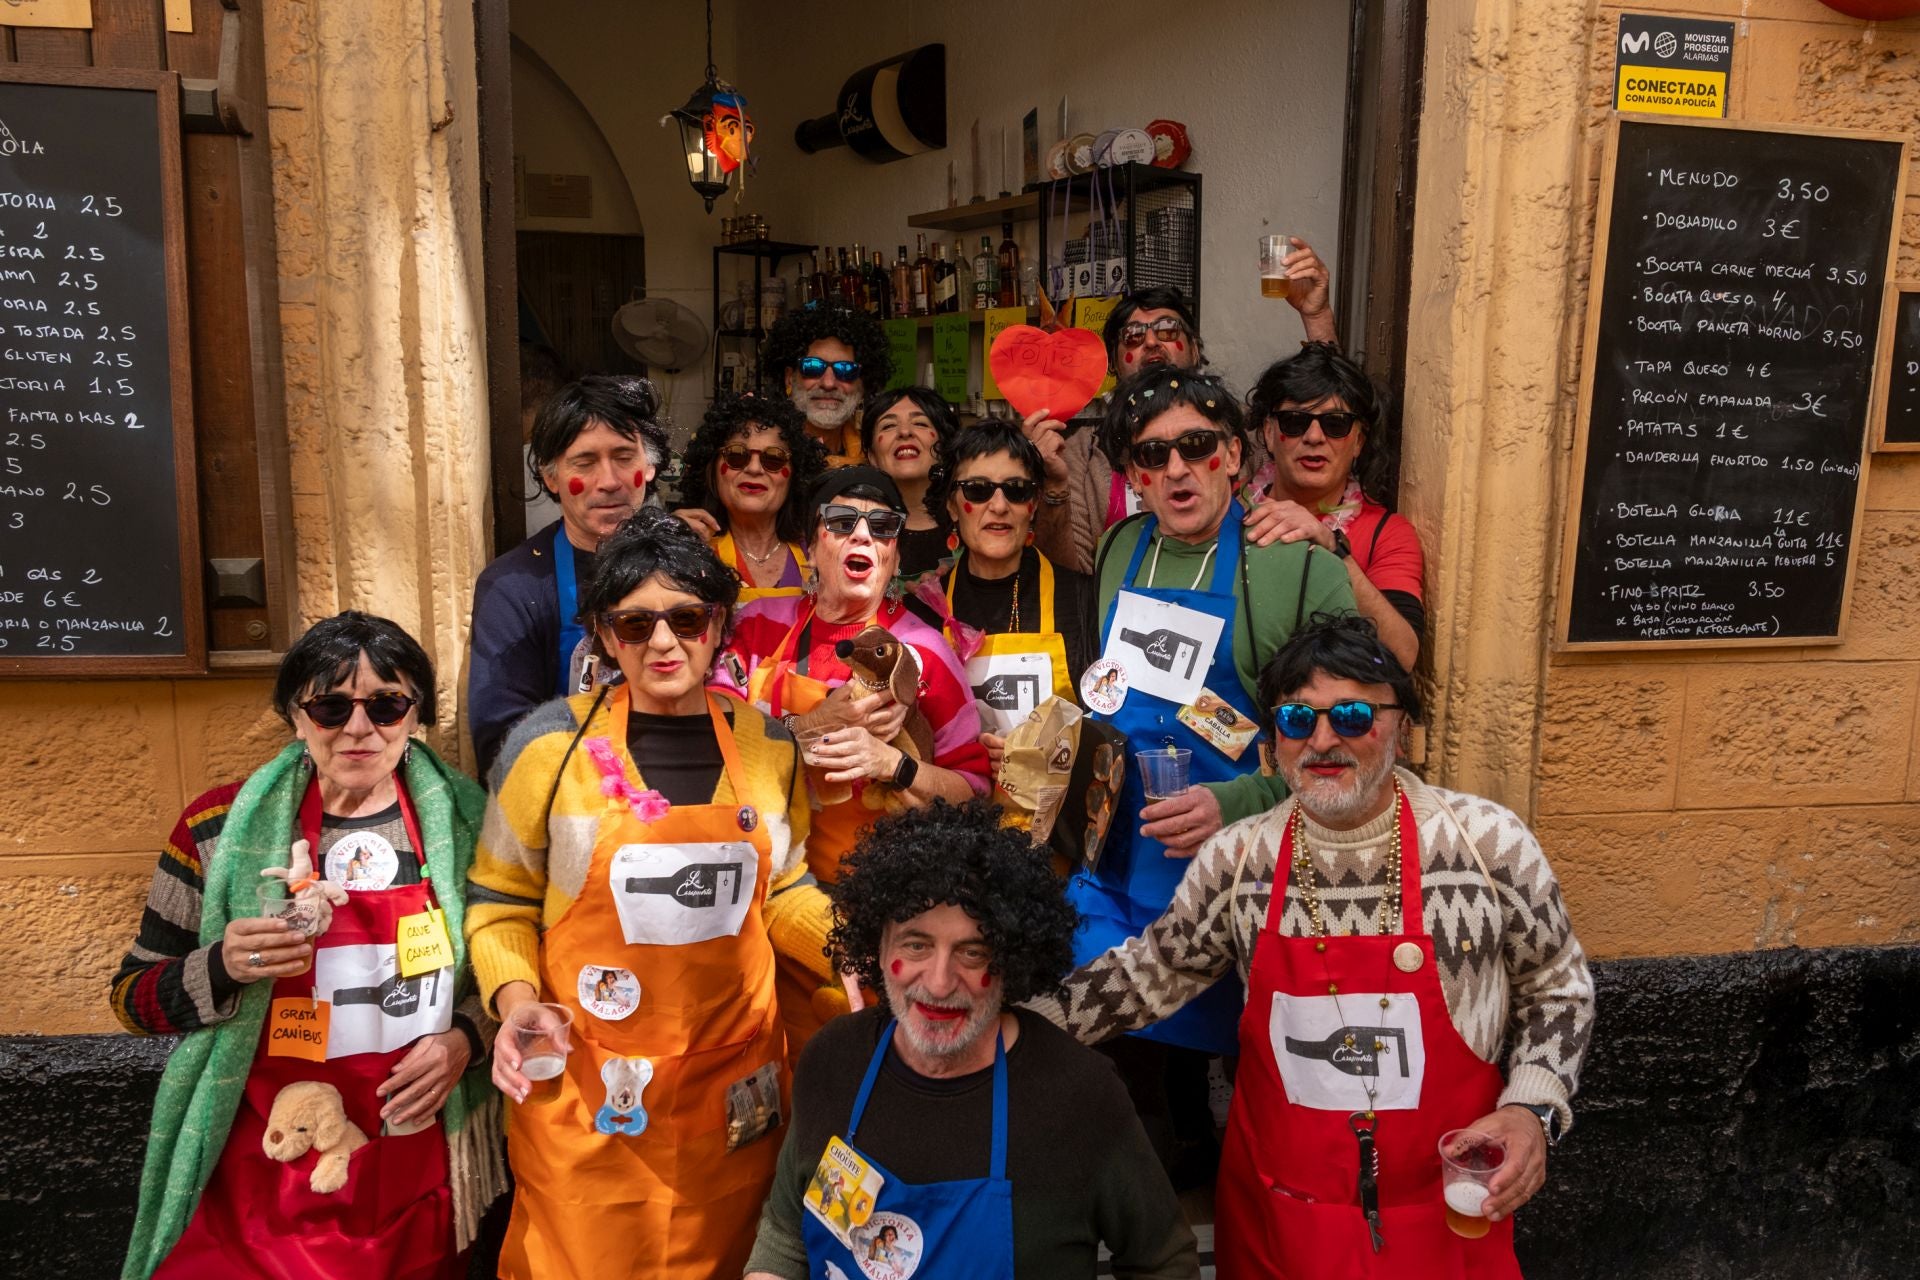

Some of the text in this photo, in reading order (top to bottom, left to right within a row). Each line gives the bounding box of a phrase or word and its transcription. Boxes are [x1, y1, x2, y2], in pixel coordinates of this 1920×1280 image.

[1685, 33, 1727, 44] MOVISTAR
[1684, 43, 1729, 54] PROSEGUR
[1683, 53, 1719, 62] ALARMAS
[1626, 78, 1717, 97] CONECTADA
[1625, 94, 1645, 102] CON
[1646, 97, 1673, 105] AVISO
[1682, 97, 1716, 108] POLICÍA
[1660, 169, 1829, 202] MENUDO 3,50
[33, 222, 48, 239] 2
[1643, 256, 1702, 274] BOCATA
[1711, 264, 1756, 277] CARNE
[1827, 268, 1866, 285] 3,50
[0, 297, 47, 311] ORIA
[1644, 288, 1692, 303] BOCATA
[1700, 290, 1755, 305] QUESO
[14, 325, 84, 340] TOSTADA
[1638, 316, 1862, 348] BOCATA PANCETA HORNO 3,50
[5, 349, 71, 363] GLUTEN
[1635, 361, 1671, 373] TAPA
[1684, 361, 1729, 376] QUESO
[89, 377, 134, 395] 1,5
[1633, 389, 1687, 404] PORCIÓN
[1699, 394, 1771, 407] EMPANADA
[8, 408, 58, 423] FANTA
[79, 411, 115, 425] KAS
[124, 412, 144, 428] 2
[1627, 420, 1697, 437] PATATAS
[9, 513, 23, 528] 3
[1618, 503, 1677, 518] BOTELLA
[1689, 504, 1741, 521] GLORIA
[1616, 534, 1676, 547] BOTELLA
[1690, 535, 1772, 548] MANZANILLA
[1778, 536, 1807, 549] GUITA
[1615, 558, 1671, 570] BOTELLA
[1685, 556, 1767, 567] MANZANILLA
[1823, 551, 1837, 568] 5
[27, 568, 102, 584] GAS 2
[1610, 585, 1643, 600] FINO
[1631, 604, 1660, 613] VASO
[154, 616, 172, 636] 2
[1204, 716, 1231, 739] CABALLA
[406, 925, 431, 938] CAVE
[406, 943, 441, 962] CANEM
[830, 1145, 861, 1176] CHOUFFE
